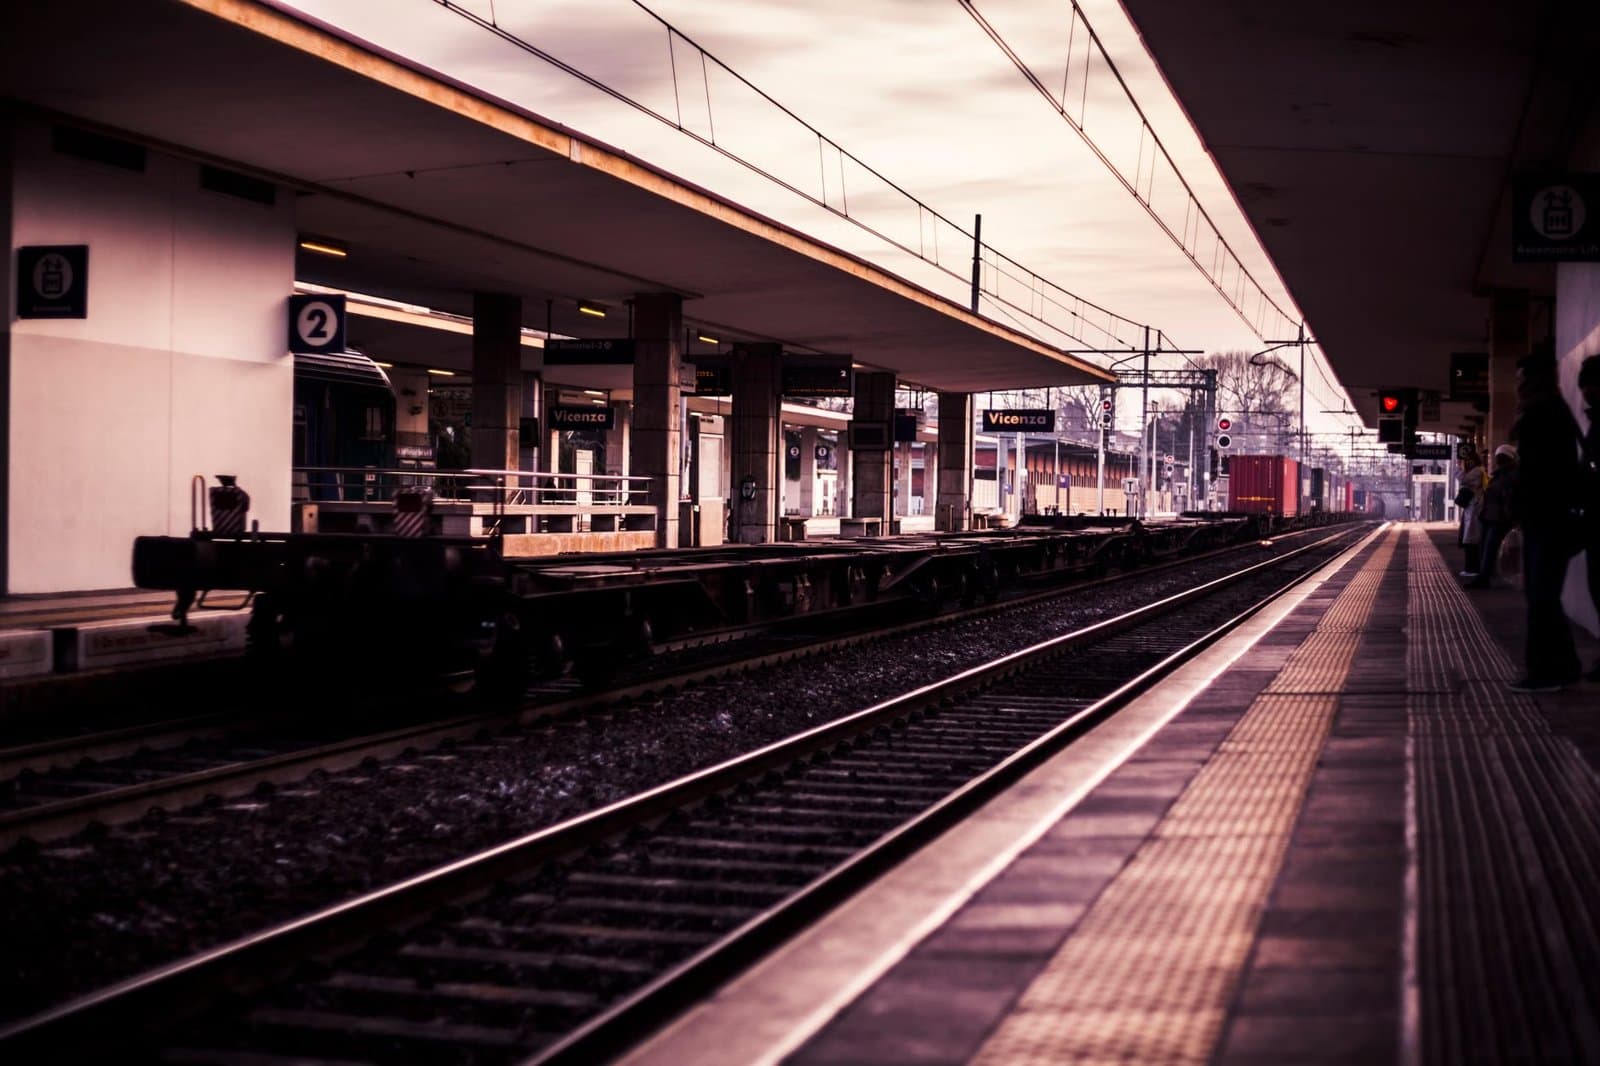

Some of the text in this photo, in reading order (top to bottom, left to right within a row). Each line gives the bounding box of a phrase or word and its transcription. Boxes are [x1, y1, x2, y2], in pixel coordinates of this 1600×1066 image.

[307, 309, 327, 337] 2
[552, 410, 606, 422] Vicenza
[988, 412, 1046, 425] Vicenza
[1127, 481, 1134, 492] T
